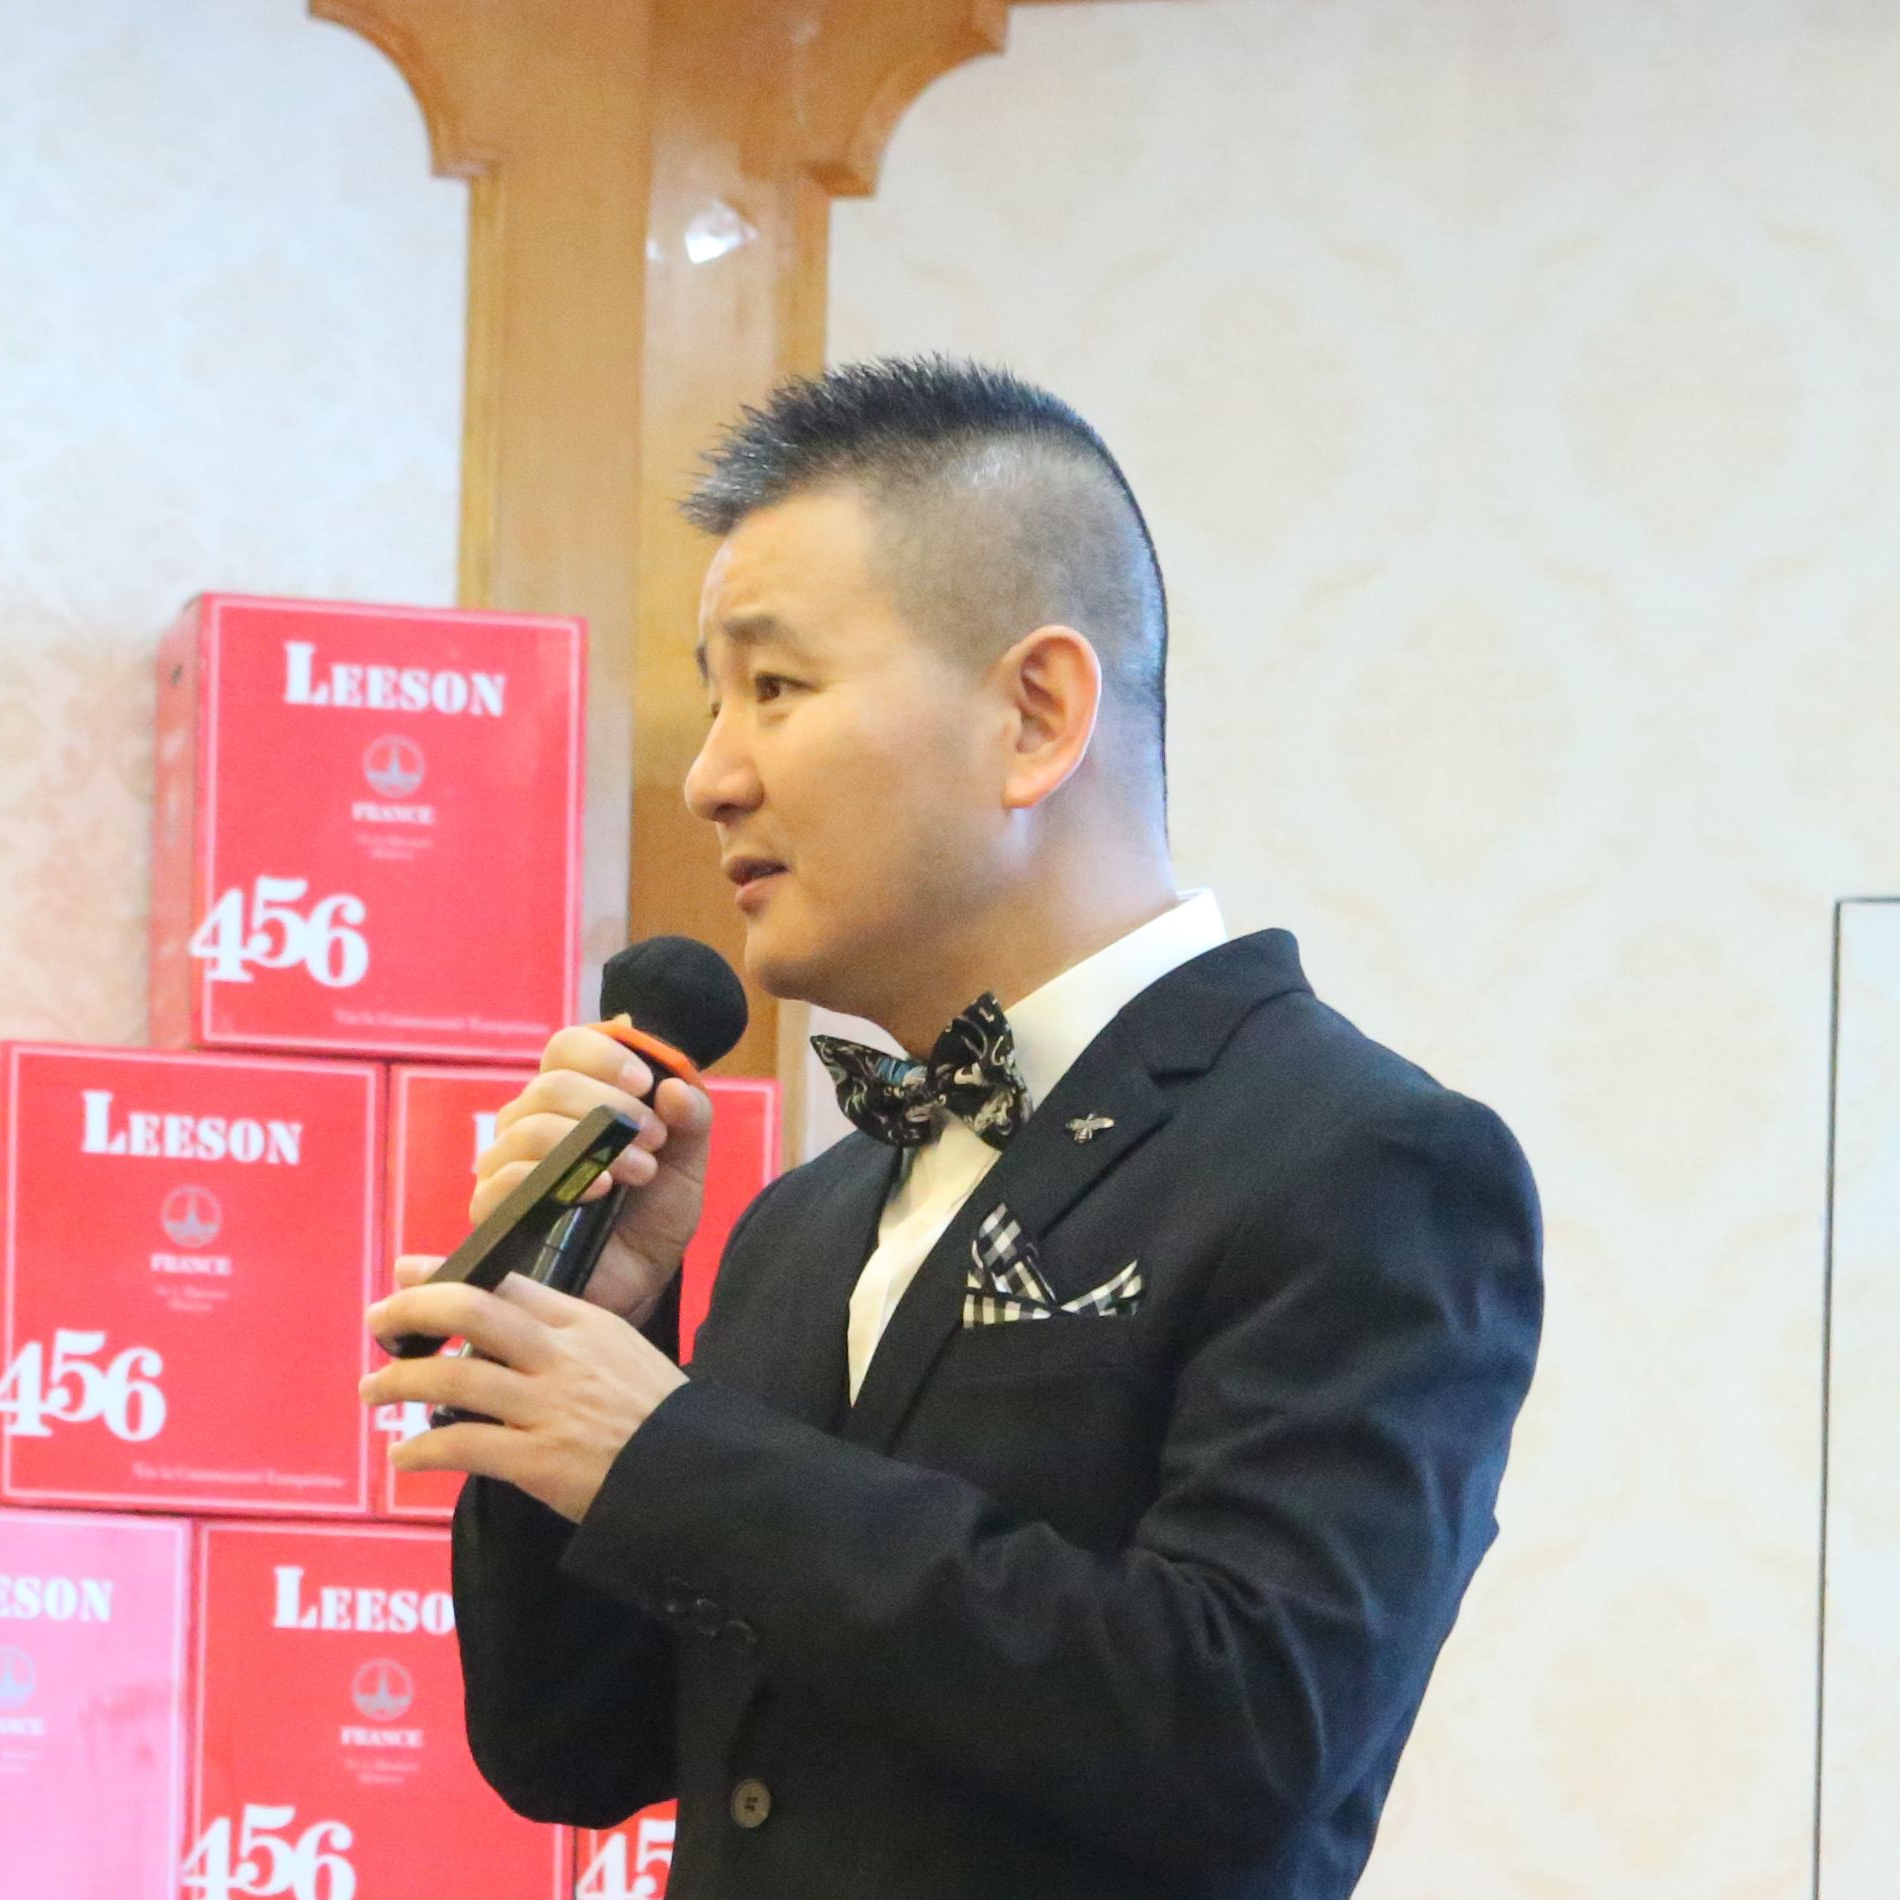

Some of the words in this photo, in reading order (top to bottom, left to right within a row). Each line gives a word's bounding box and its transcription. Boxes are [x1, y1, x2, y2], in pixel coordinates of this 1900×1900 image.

[285, 641, 505, 716] LEESON
[352, 802, 434, 825] FRANCE
[190, 876, 368, 988] 456
[82, 1090, 302, 1164] LEESON
[150, 1253, 231, 1275] FRANCE
[273, 1566, 455, 1635] LEESO
[341, 1727, 422, 1748] FRANCE
